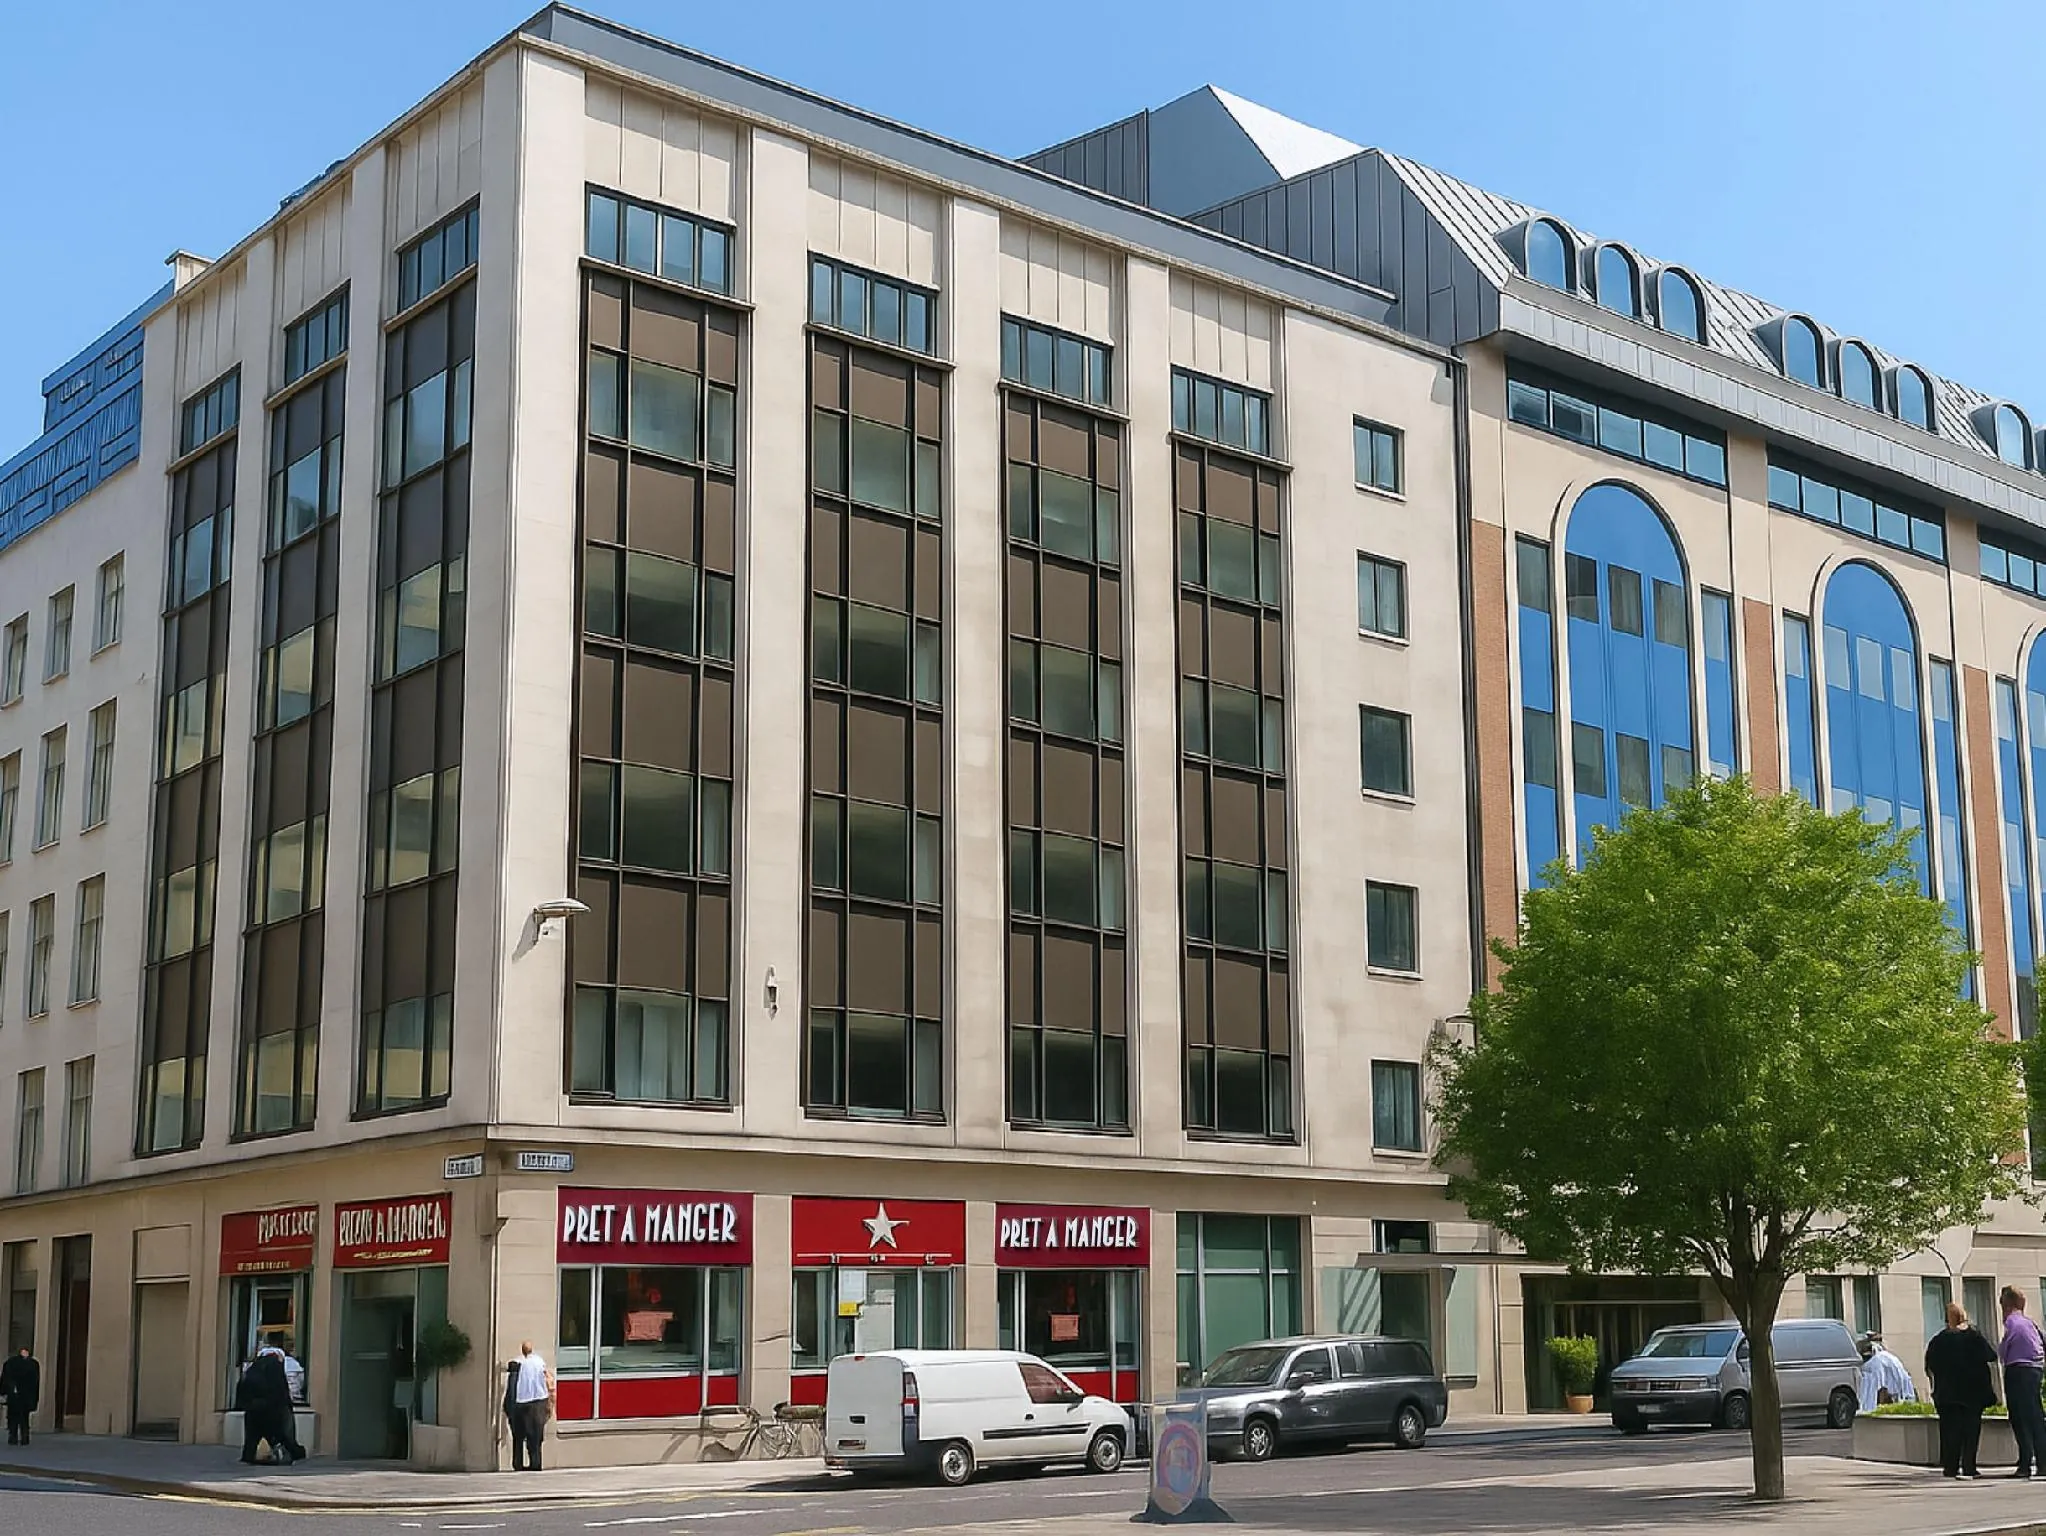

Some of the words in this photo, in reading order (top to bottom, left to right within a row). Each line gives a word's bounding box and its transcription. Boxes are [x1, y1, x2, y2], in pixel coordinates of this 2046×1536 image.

[563, 1204, 616, 1243] PRET
[621, 1204, 637, 1243] A
[644, 1203, 737, 1243] MANGER
[1000, 1217, 1042, 1248] PRET
[1045, 1217, 1058, 1248] A
[1064, 1216, 1138, 1248] MANGER
